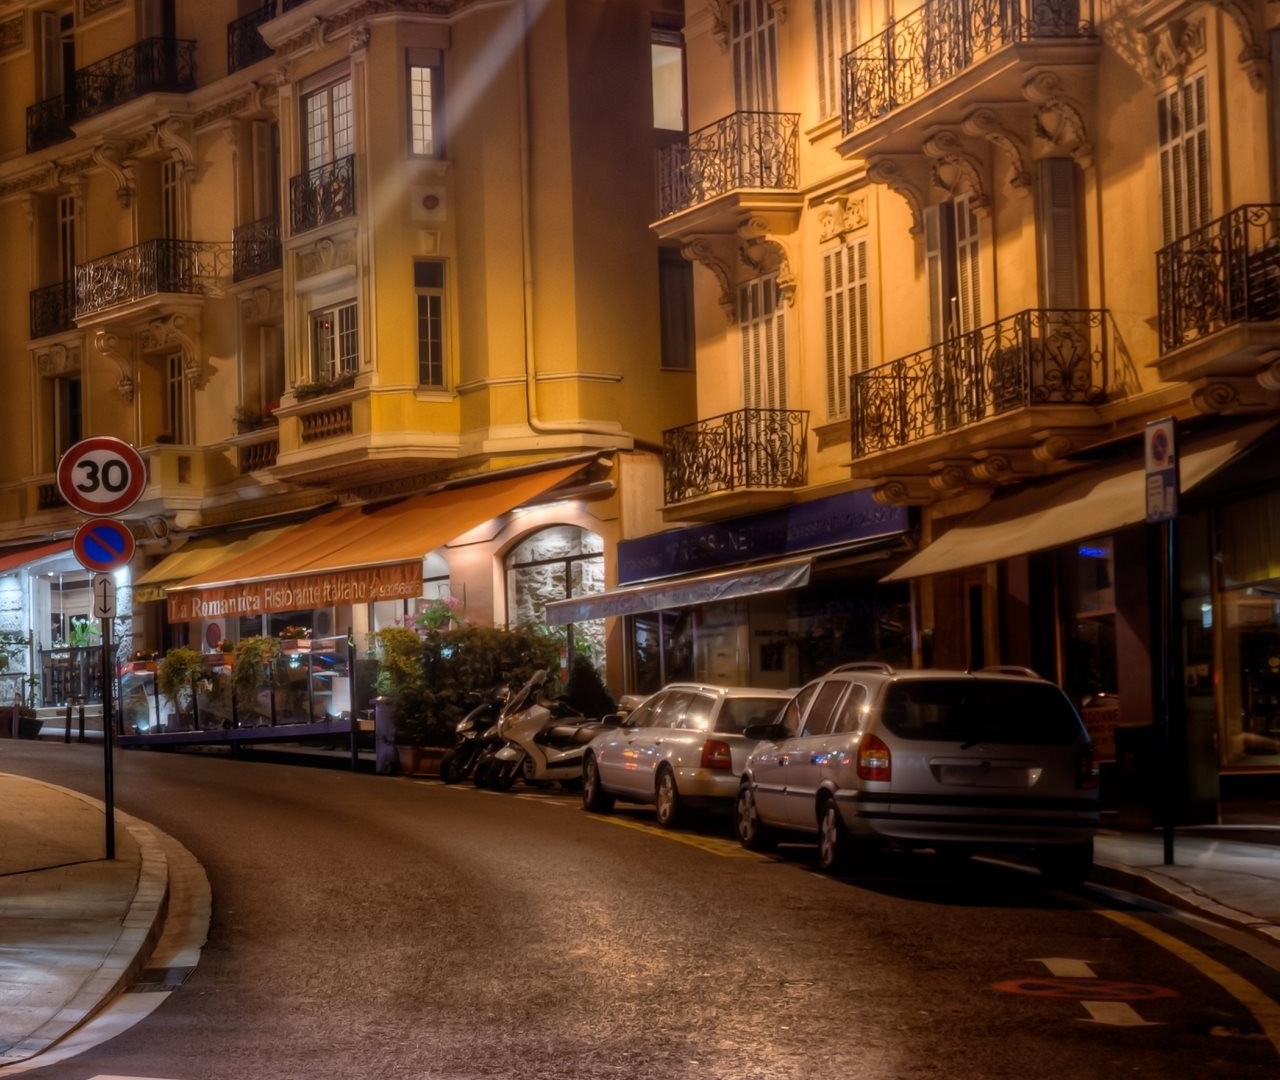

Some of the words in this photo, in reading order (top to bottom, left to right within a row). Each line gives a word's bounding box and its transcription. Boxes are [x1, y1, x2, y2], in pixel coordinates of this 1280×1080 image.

[76, 460, 129, 493] 30
[171, 598, 188, 618] La
[191, 591, 260, 617] Romantica
[264, 587, 321, 609] Ristorante
[323, 579, 366, 602] Italiano
